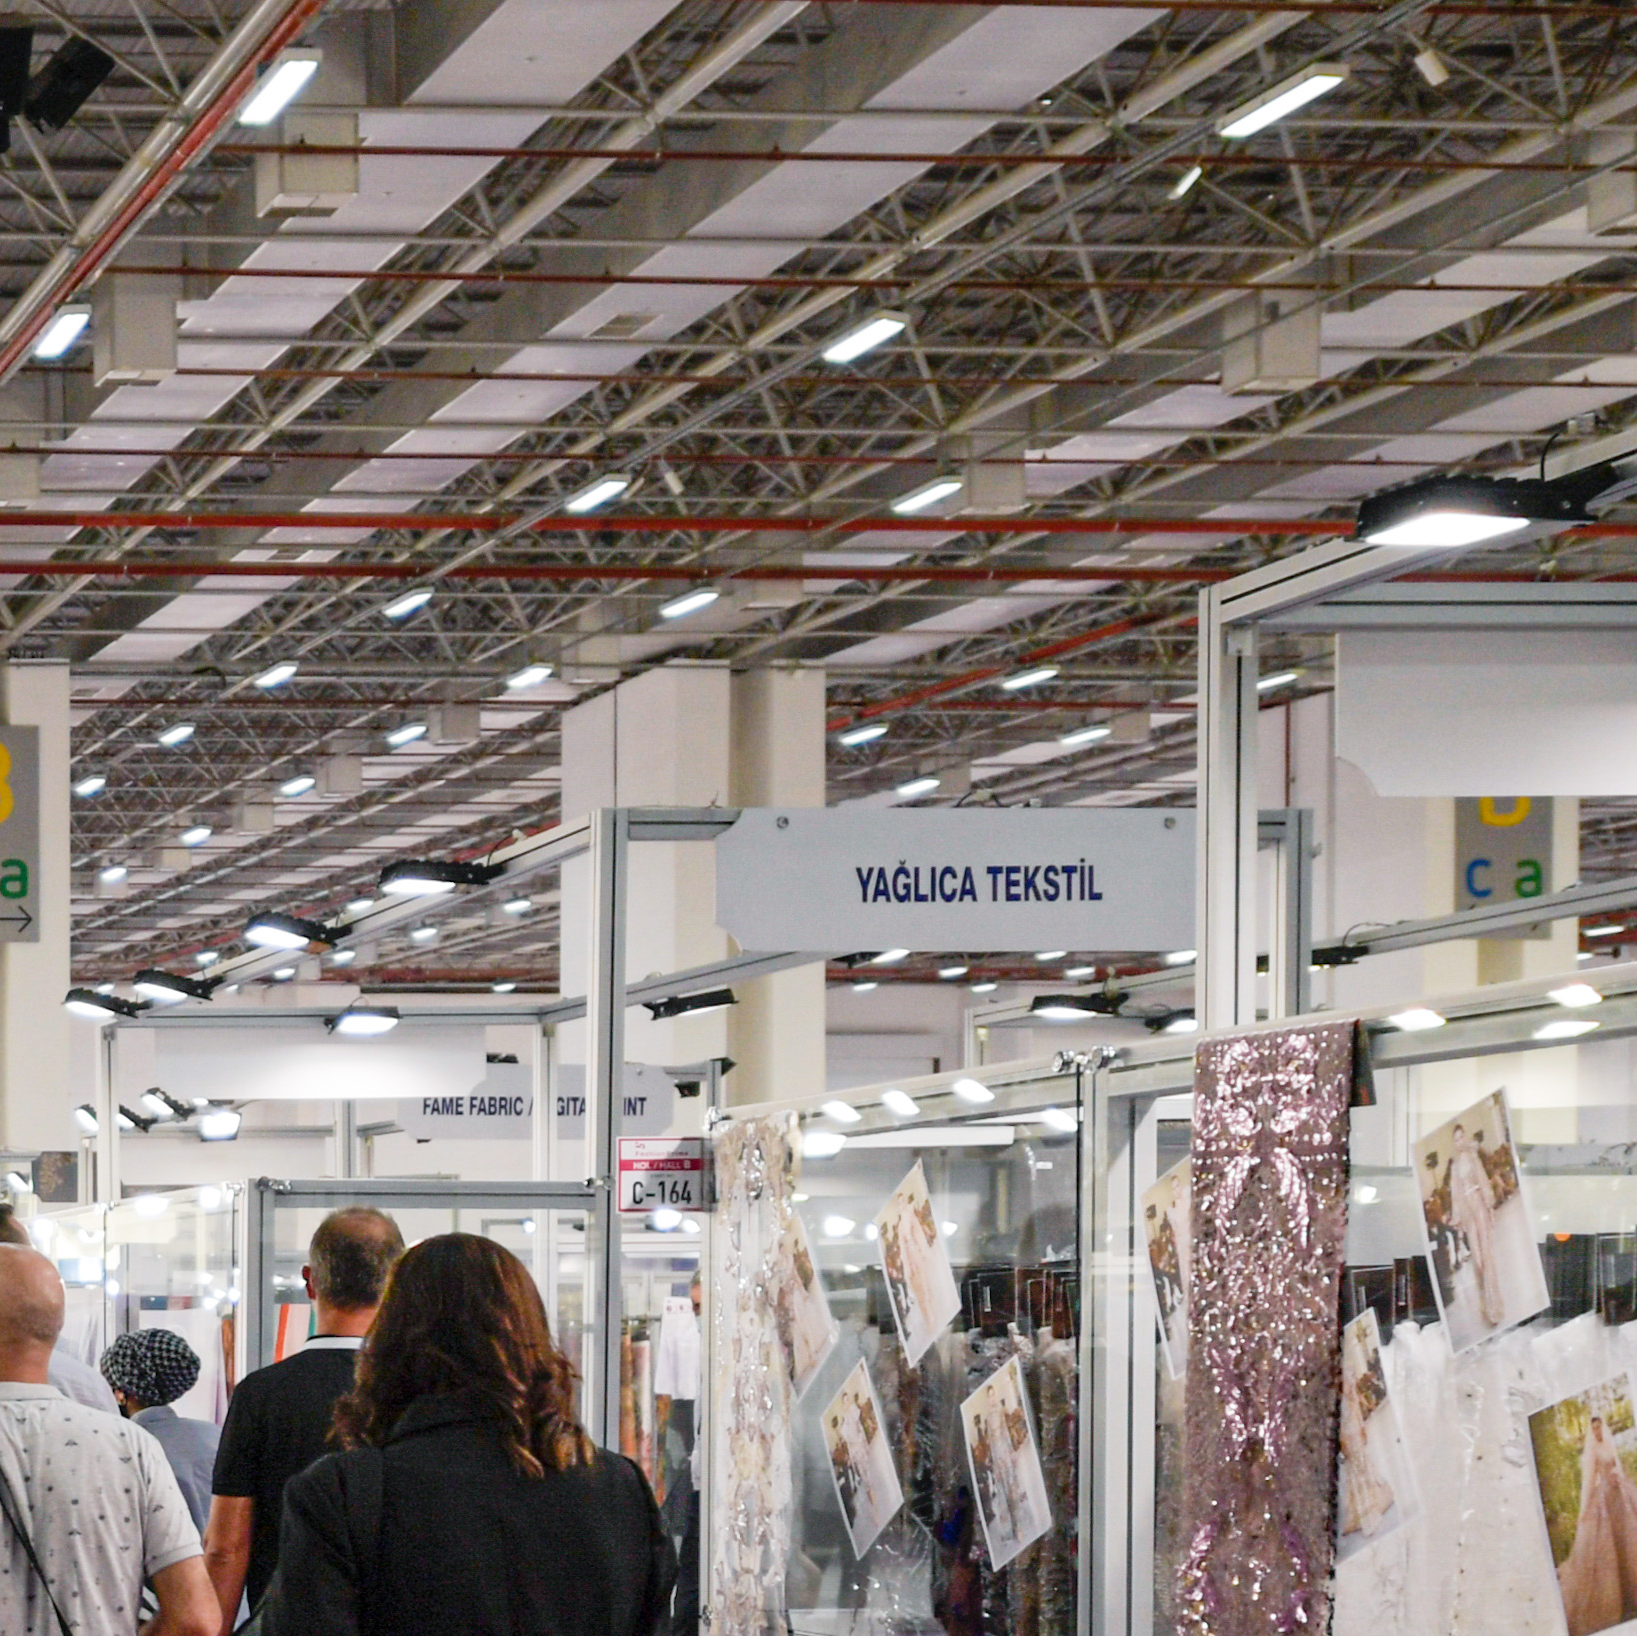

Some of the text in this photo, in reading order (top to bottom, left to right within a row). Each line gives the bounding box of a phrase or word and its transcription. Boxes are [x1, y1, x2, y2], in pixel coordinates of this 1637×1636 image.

[855, 857, 1103, 903] YAĞLICA TEKSTİL
[1514, 858, 1542, 898] a
[423, 1097, 464, 1116] FAME
[469, 1096, 524, 1116] FABRIC
[660, 1161, 681, 1170] HALL
[683, 1160, 691, 1169] B
[632, 1180, 693, 1205] C-164
